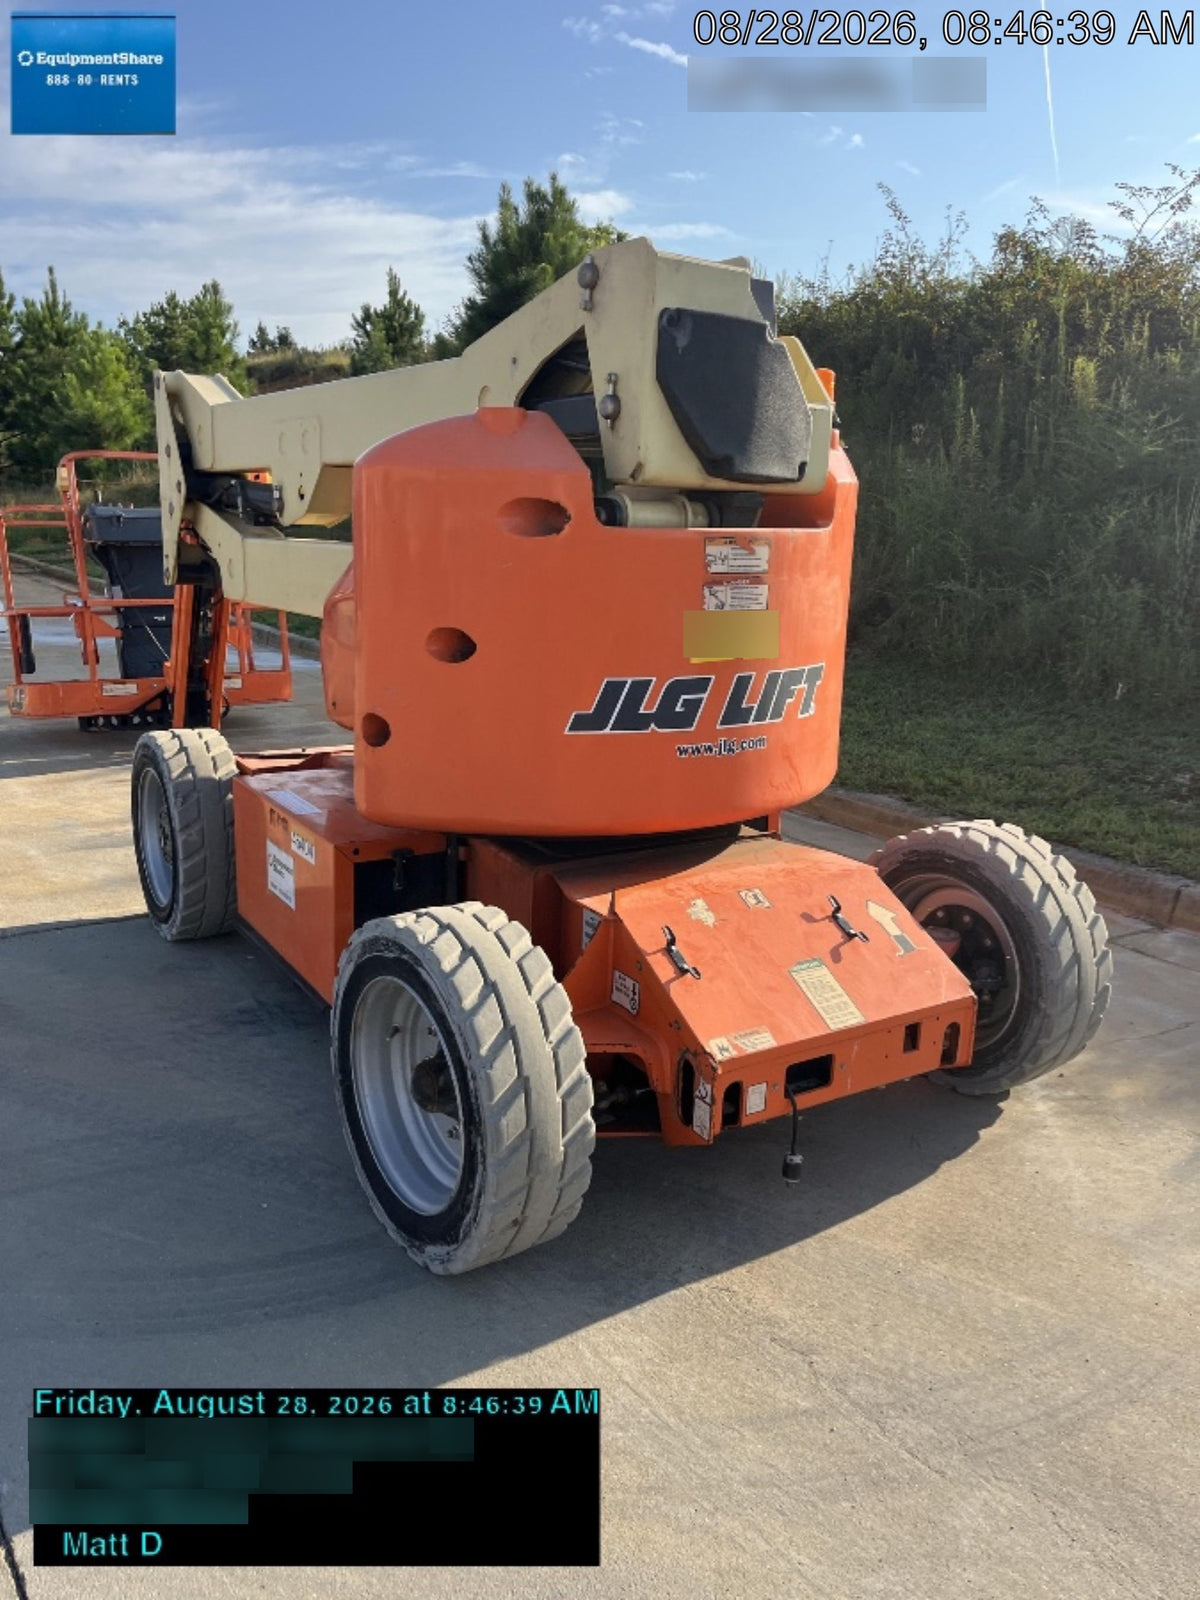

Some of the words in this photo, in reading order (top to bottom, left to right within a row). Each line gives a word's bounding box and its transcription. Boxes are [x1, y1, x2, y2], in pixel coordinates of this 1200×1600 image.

[564, 675, 715, 734] JLG
[716, 662, 825, 729] LIFT
[675, 736, 767, 757] www.jlg.com
